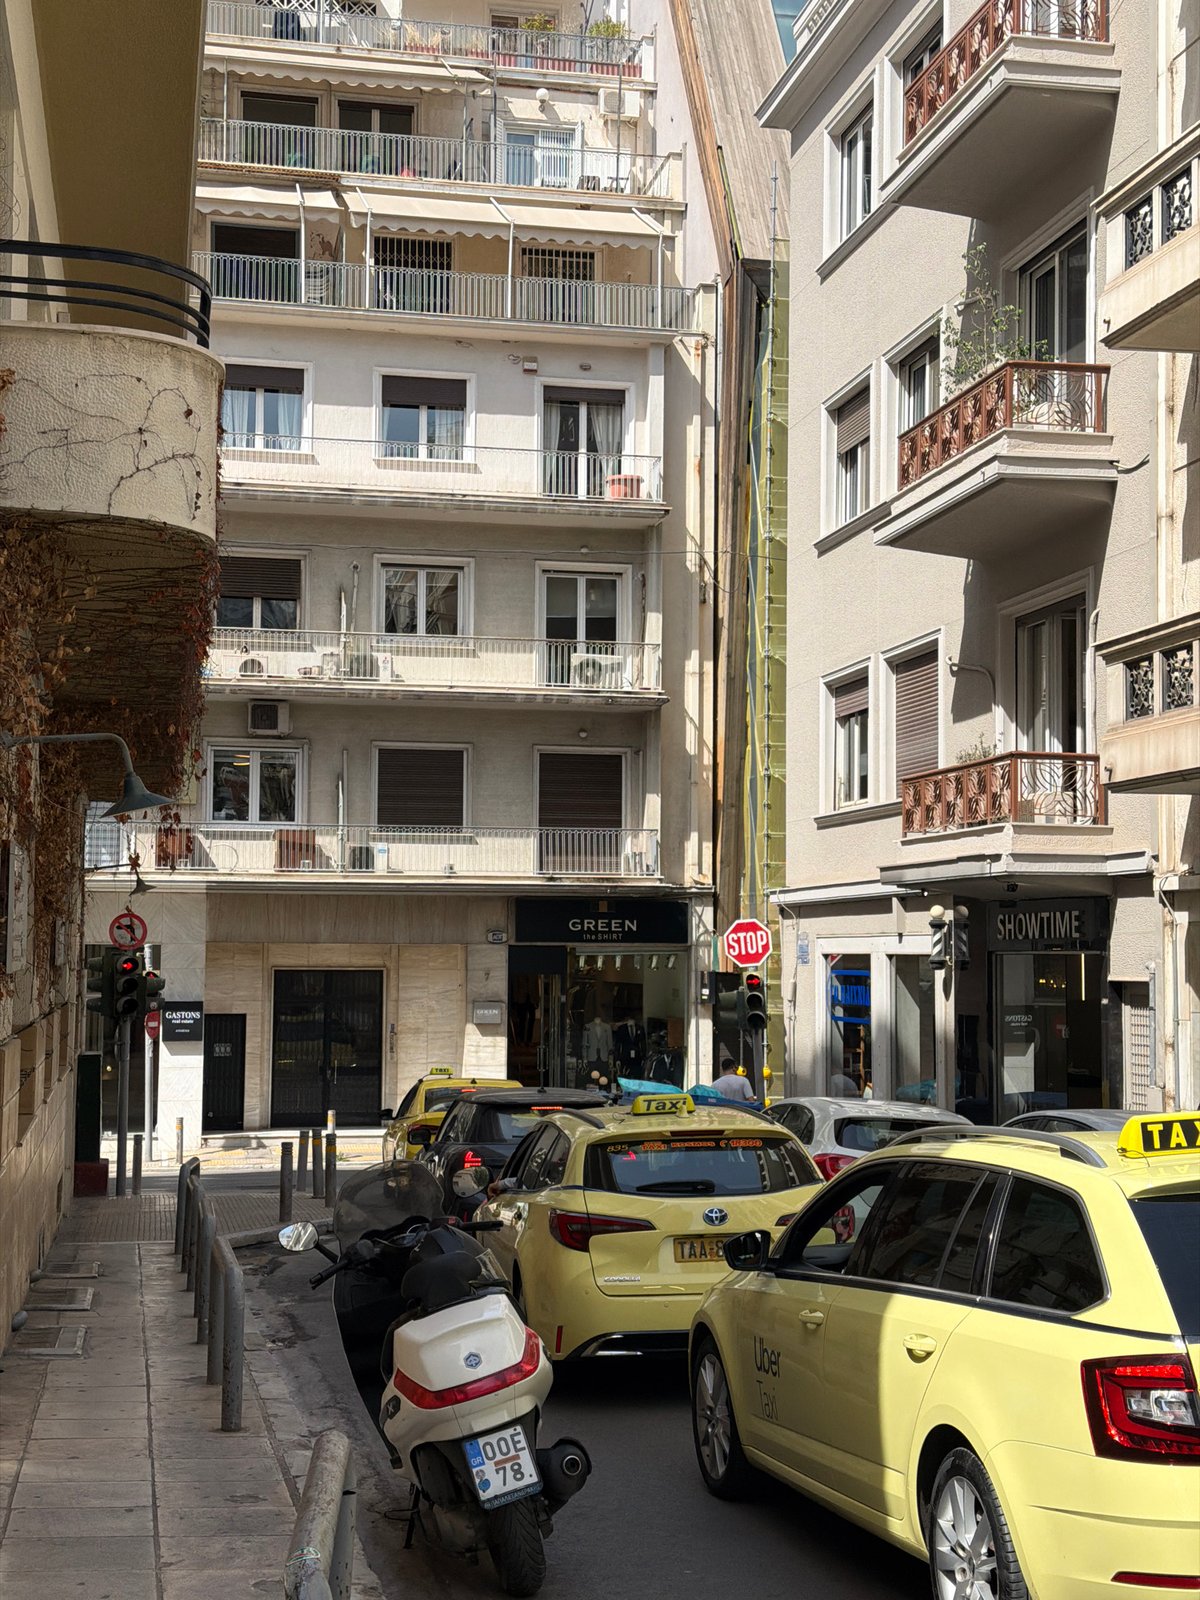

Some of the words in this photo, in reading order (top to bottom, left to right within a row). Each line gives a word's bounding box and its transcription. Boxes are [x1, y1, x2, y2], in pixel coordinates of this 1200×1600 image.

[568, 918, 638, 931] GREEN
[996, 910, 1080, 940] SHOWTIME
[728, 930, 768, 956] STOP
[165, 1011, 201, 1019] GASTONS
[677, 1240, 725, 1260] TAA-8
[754, 1335, 780, 1378] Uber
[756, 1380, 778, 1421] Taxi
[471, 1456, 483, 1466] GR
[495, 1462, 525, 1487] 78
